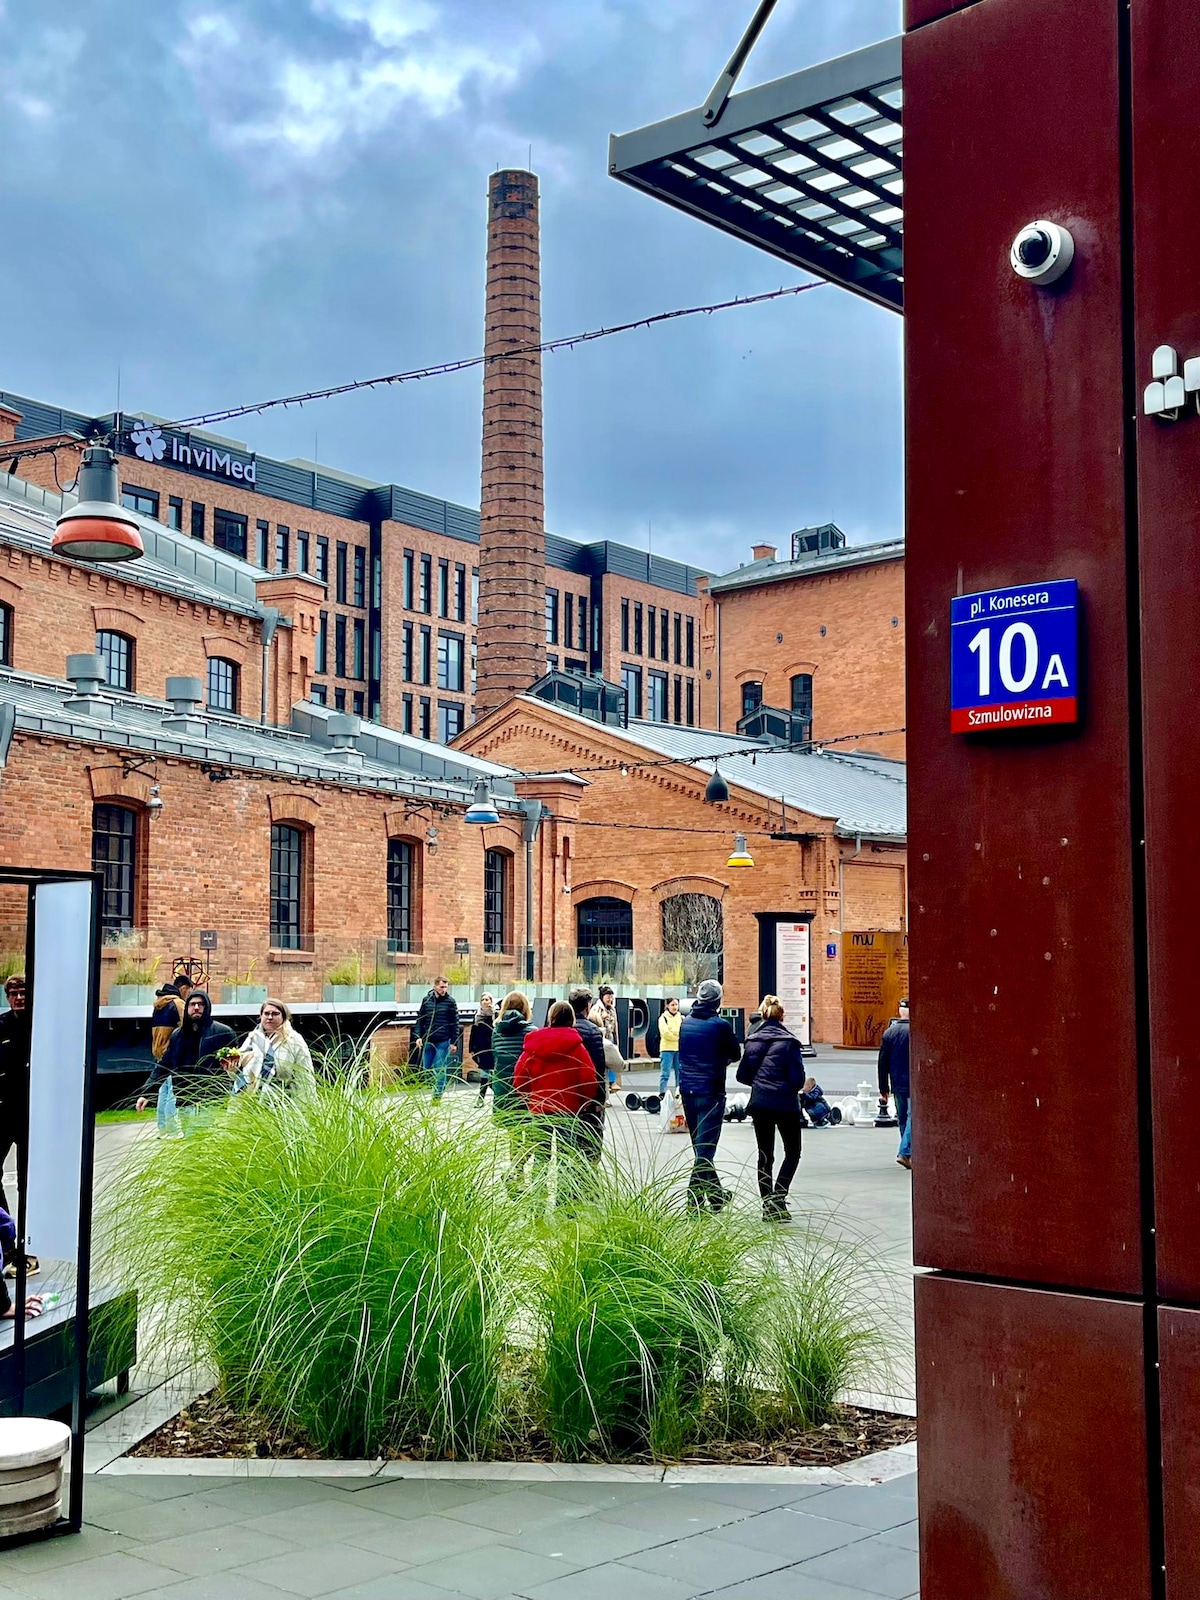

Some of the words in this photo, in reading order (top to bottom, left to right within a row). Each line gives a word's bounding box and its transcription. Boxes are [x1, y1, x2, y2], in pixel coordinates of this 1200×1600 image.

[172, 438, 257, 483] InviMed
[970, 598, 985, 618] pl.
[989, 591, 1049, 611] Konesera
[968, 704, 1052, 725] Szmulowizna
